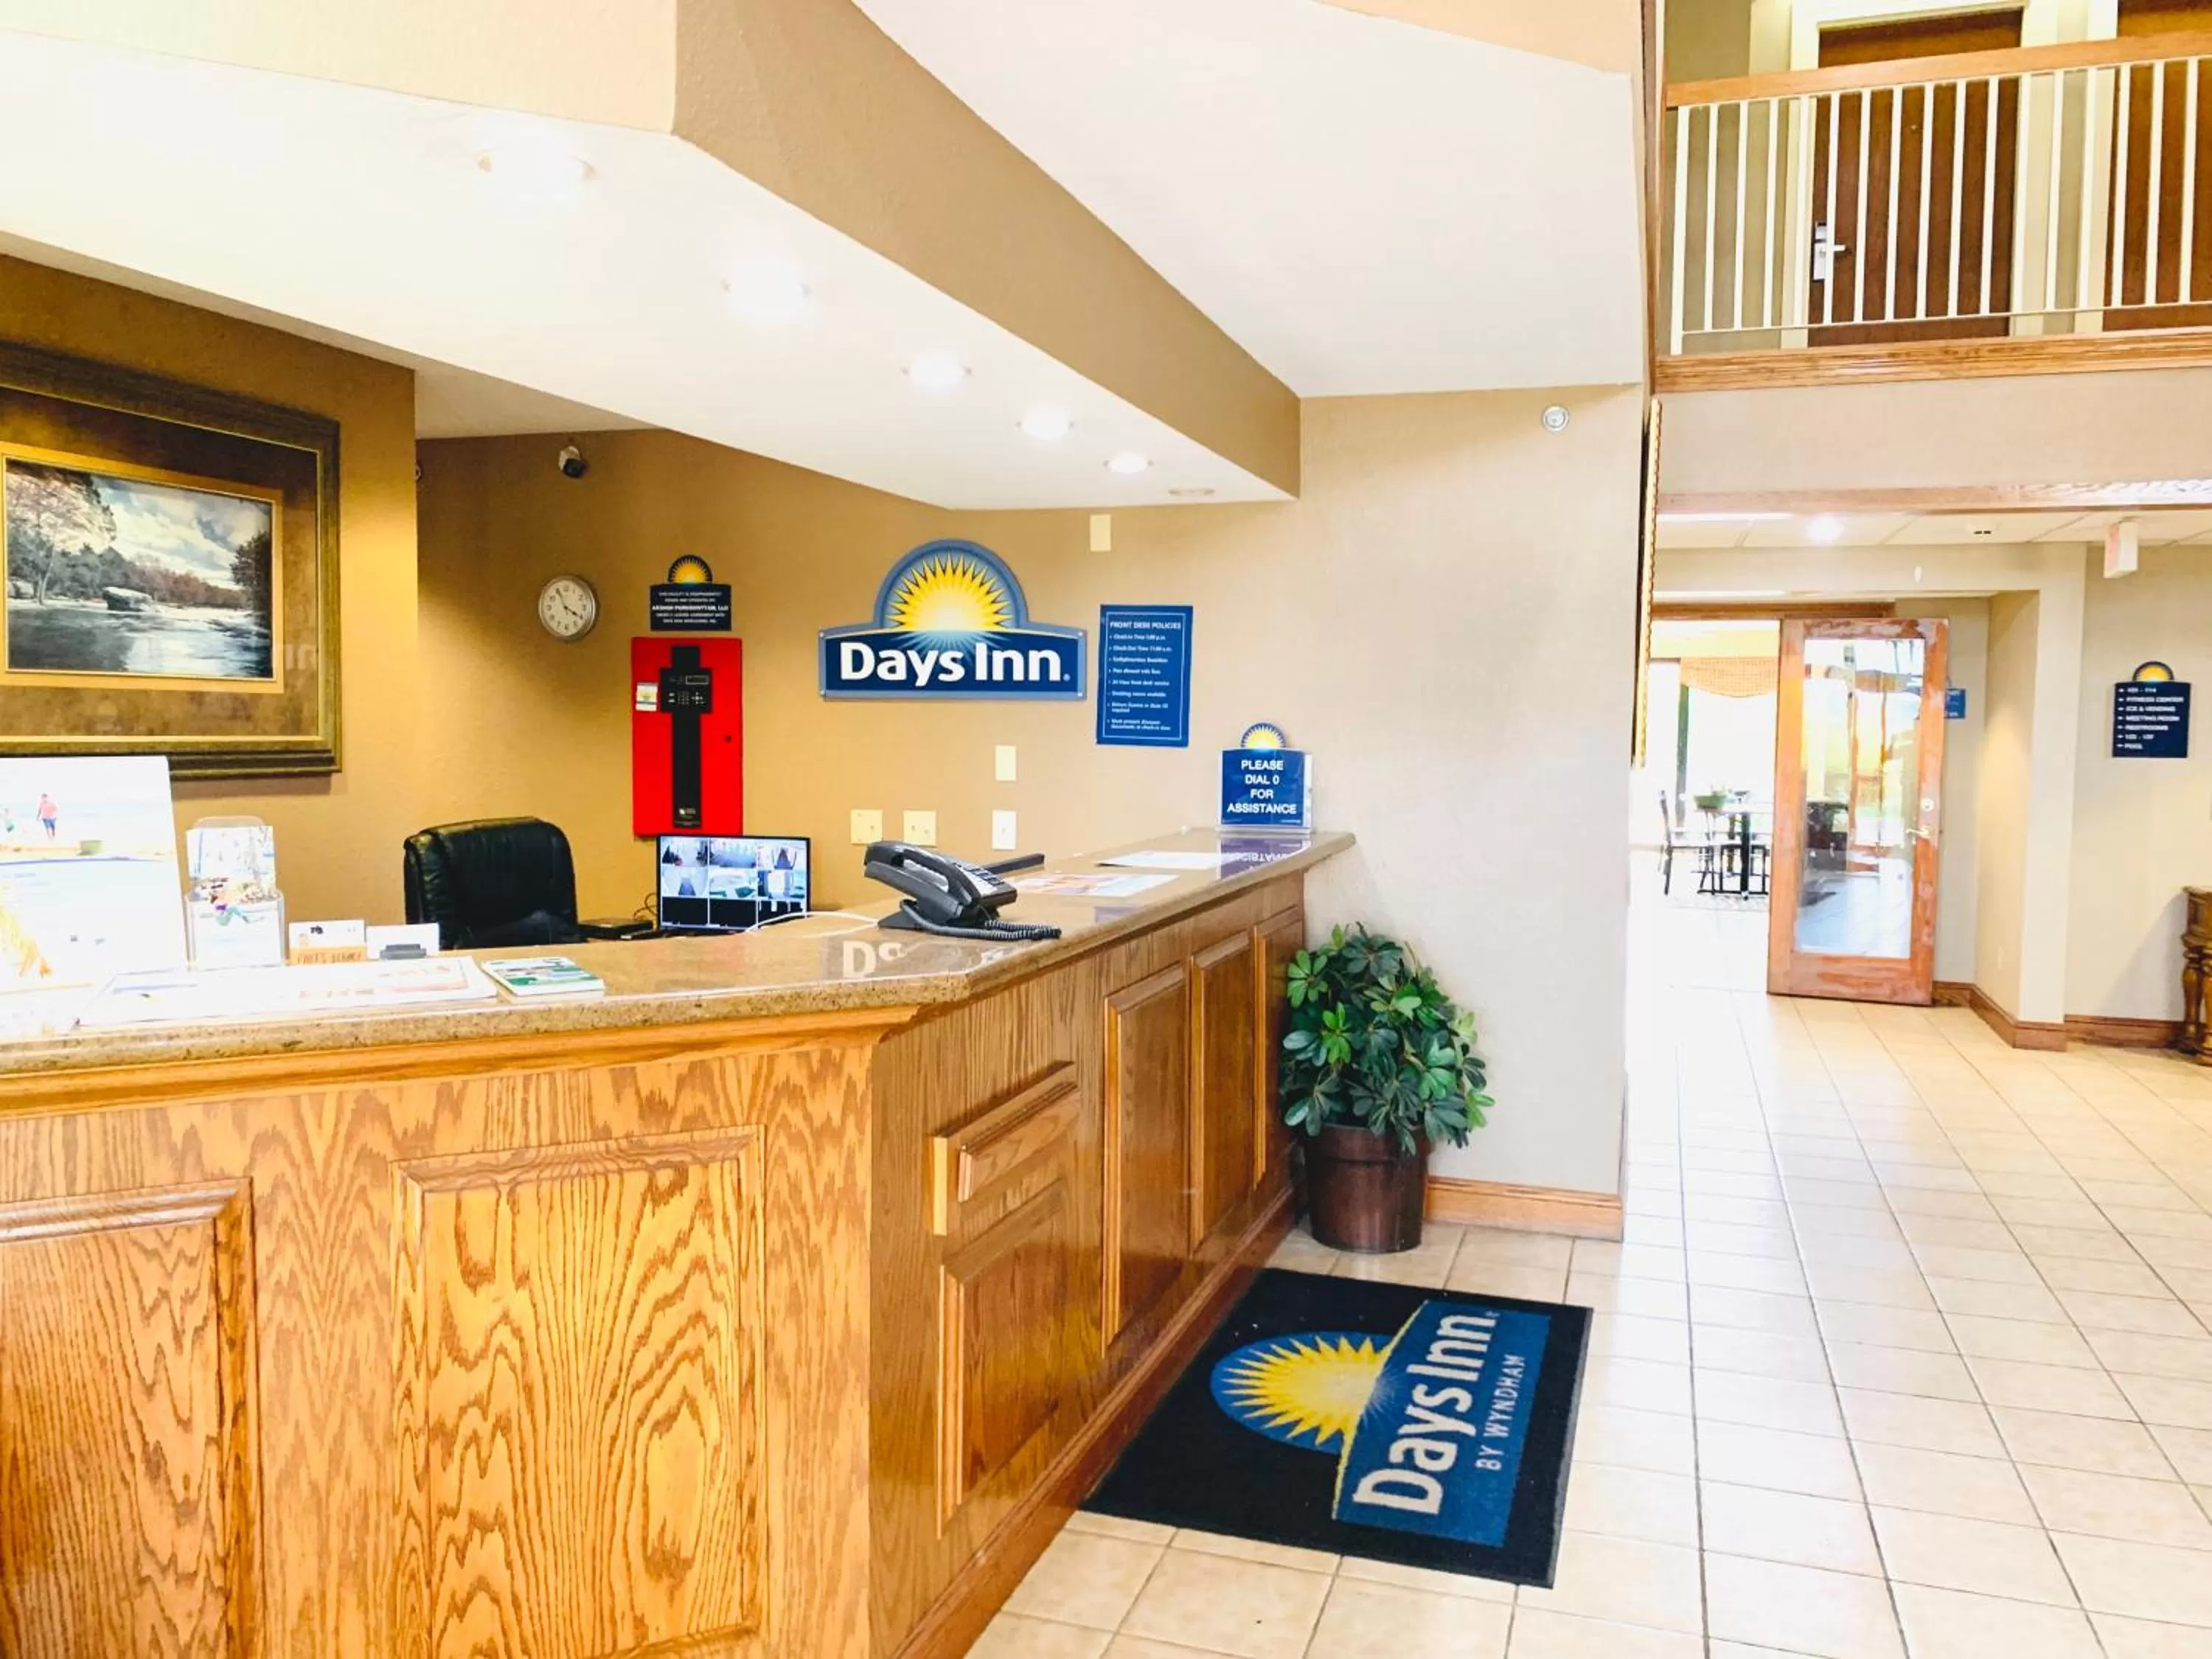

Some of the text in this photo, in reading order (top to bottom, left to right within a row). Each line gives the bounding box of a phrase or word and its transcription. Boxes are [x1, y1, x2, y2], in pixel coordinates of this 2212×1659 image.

[840, 641, 1062, 687] Days Inn
[1241, 759, 1284, 771] PLEASE
[1245, 774, 1270, 785] DIAL
[1250, 789, 1275, 799] FOR
[1226, 802, 1298, 815] ASSISTANCE
[1352, 1315, 1497, 1515] Days Inn
[1475, 1354, 1526, 1470] BY WYNDHAM
